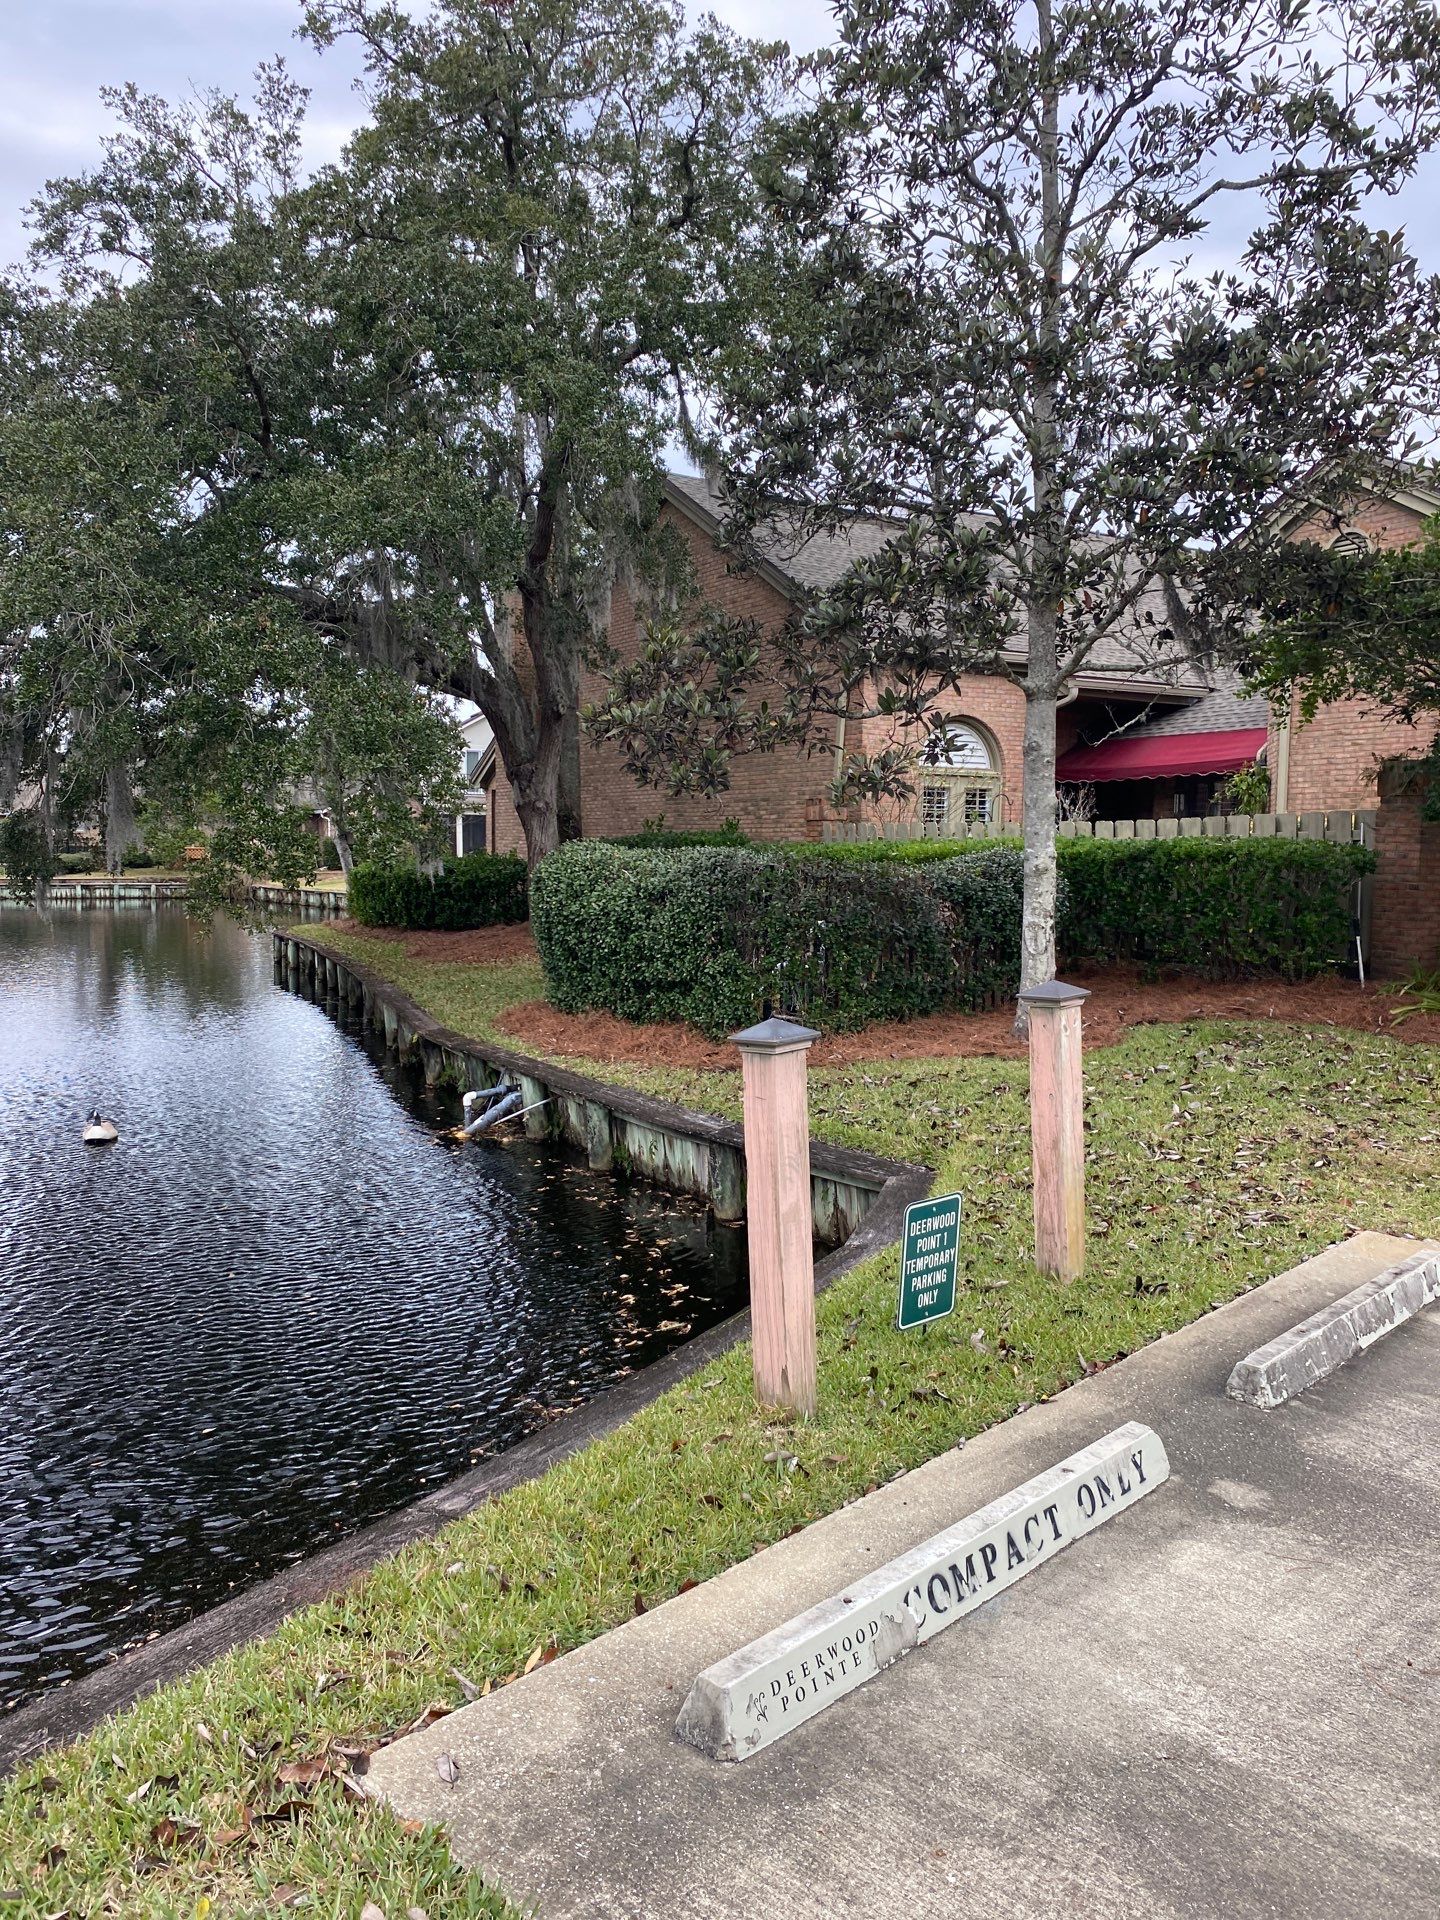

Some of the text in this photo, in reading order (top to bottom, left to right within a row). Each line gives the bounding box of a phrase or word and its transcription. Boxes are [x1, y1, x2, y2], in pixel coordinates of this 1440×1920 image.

[910, 1211, 956, 1236] DEERWOOD
[917, 1231, 948, 1253] POINT 1
[906, 1247, 955, 1275] TEMPORARY
[911, 1268, 947, 1291] PARKING
[917, 1288, 939, 1308] ONLY
[903, 1449, 1147, 1628] COMPACT ONLY
[770, 1620, 878, 1697] DEERWOOD
[781, 1651, 862, 1713] POINTE
